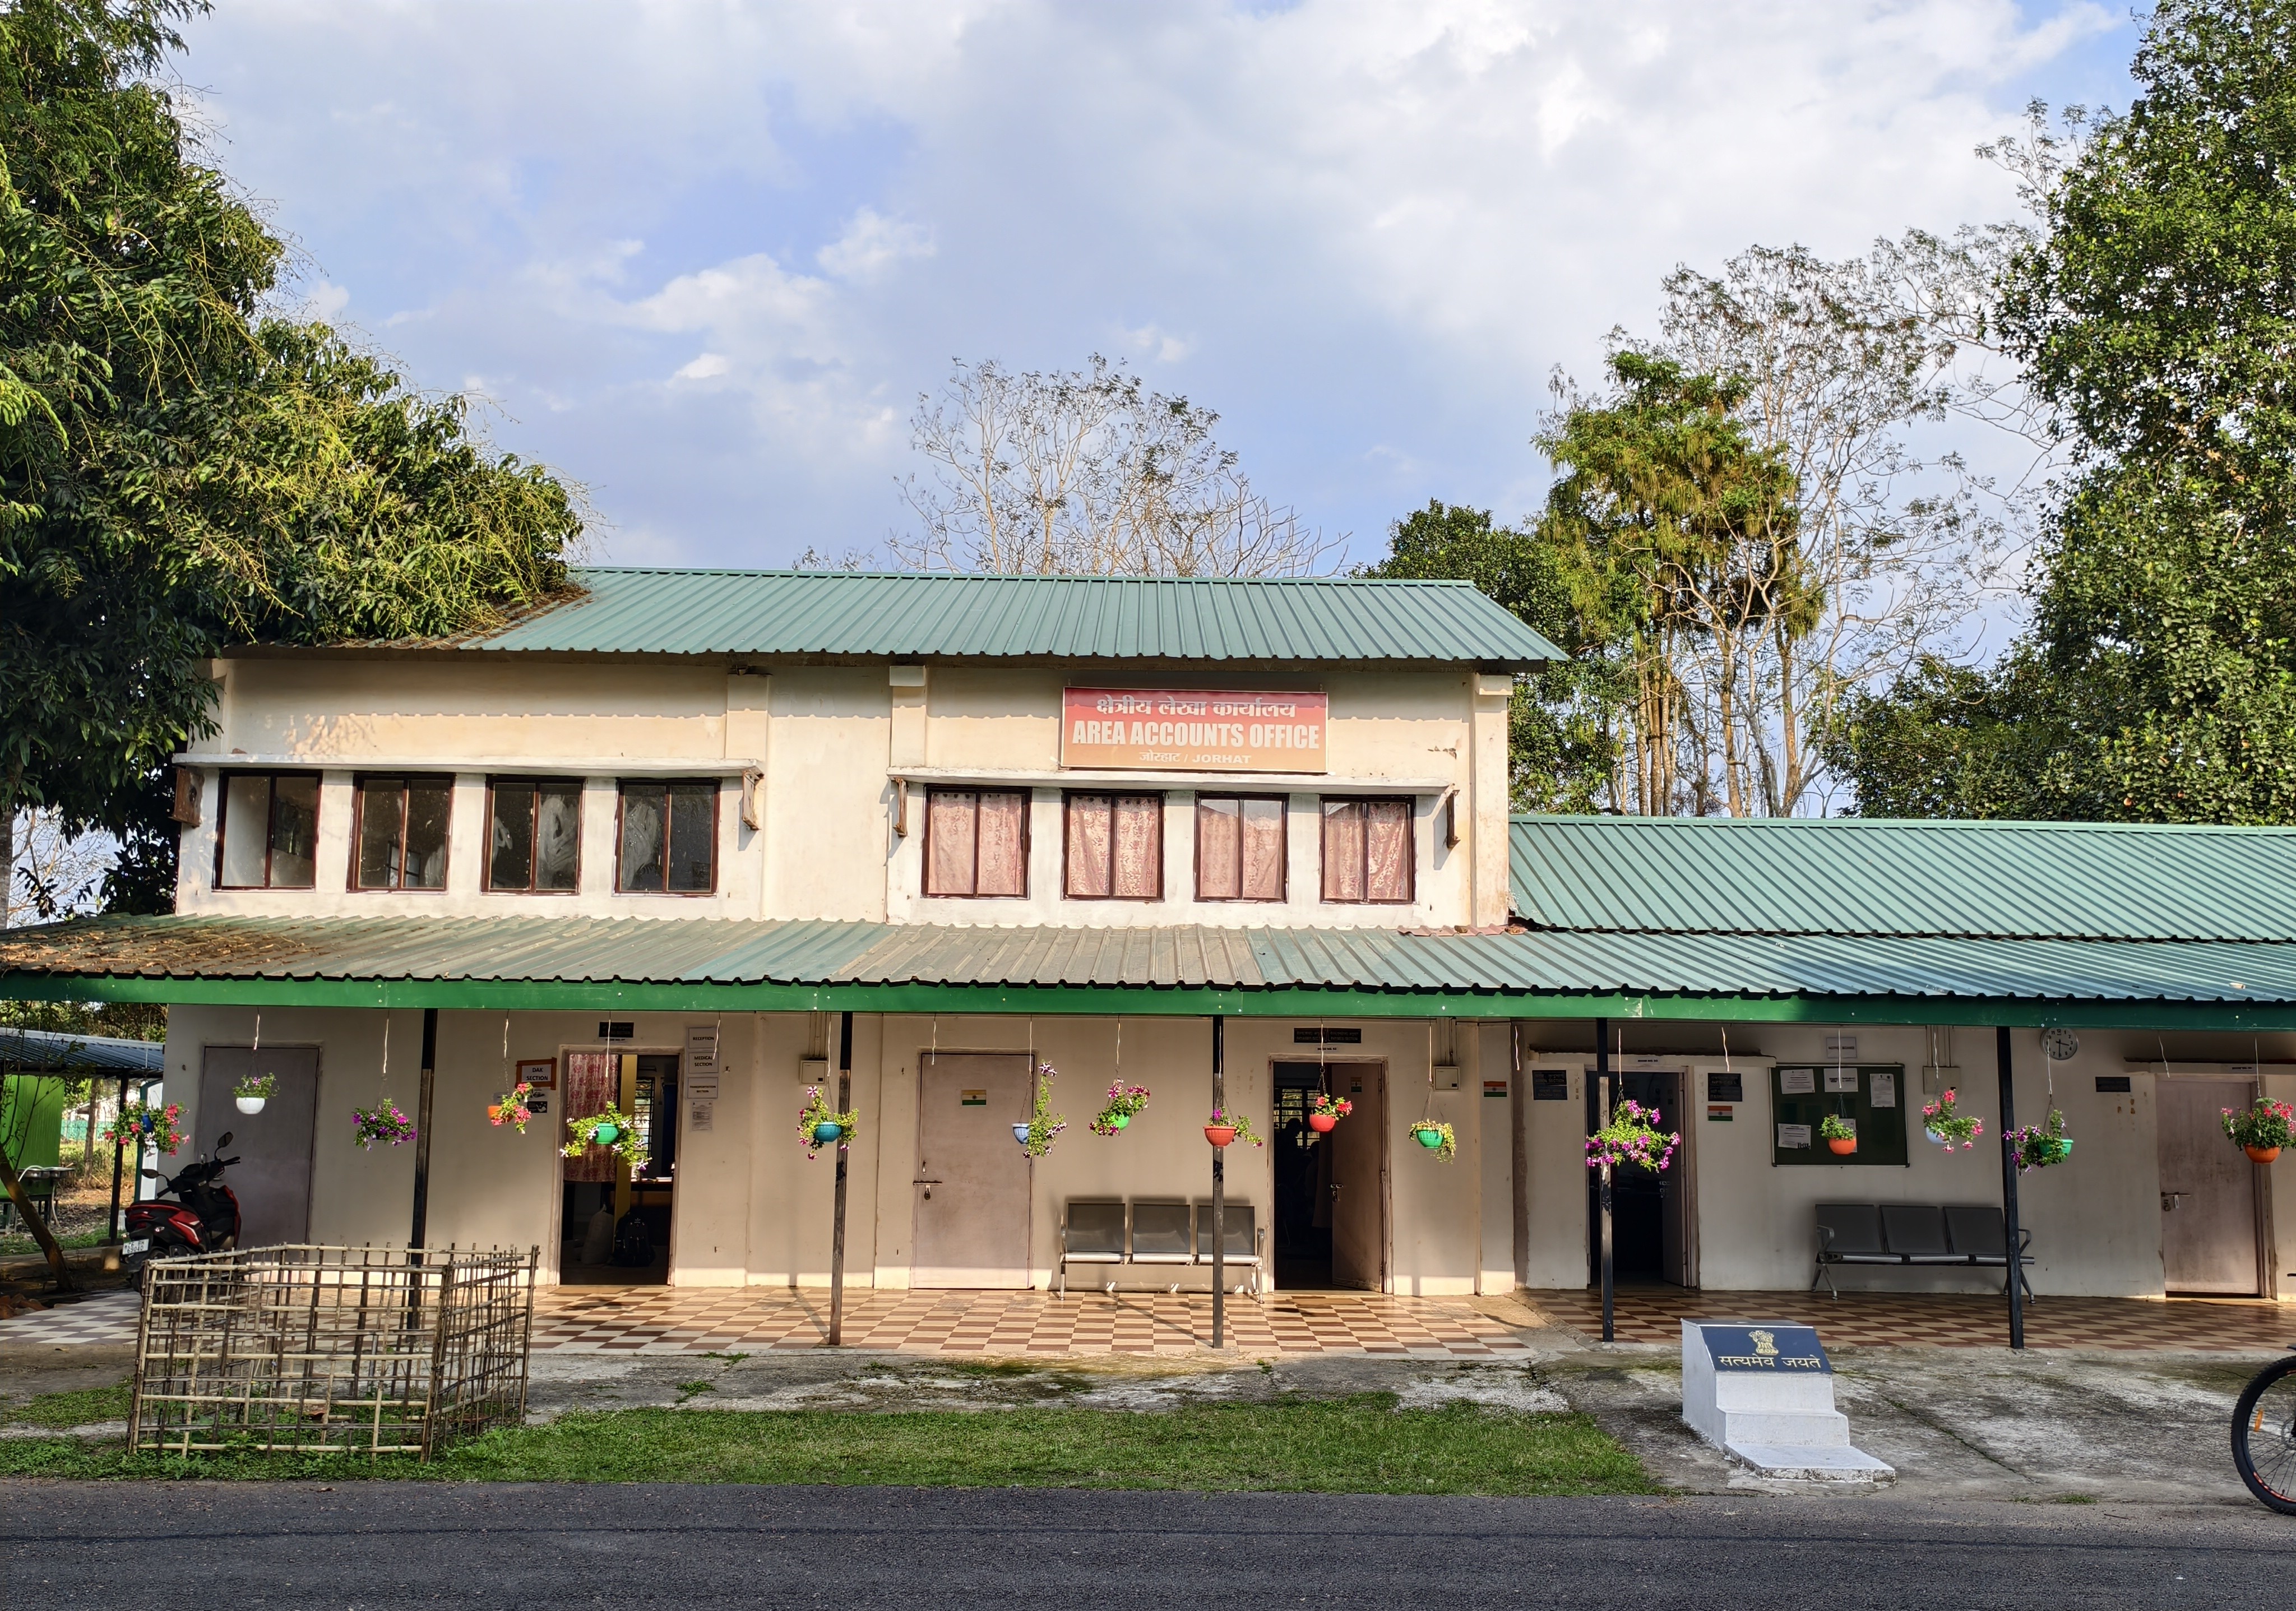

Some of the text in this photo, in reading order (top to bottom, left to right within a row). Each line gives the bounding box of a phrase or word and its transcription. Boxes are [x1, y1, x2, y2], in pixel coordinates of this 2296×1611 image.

[1096, 694, 1297, 717] क्षेत्रीय लेखा कार्यालय
[1072, 720, 1320, 749] AREA ACCOUNTS OFFICE
[1139, 749, 1182, 762] जोरहाट
[1192, 754, 1252, 763] JORHAT
[1718, 1353, 1821, 1368] सत्यमेव जयते
